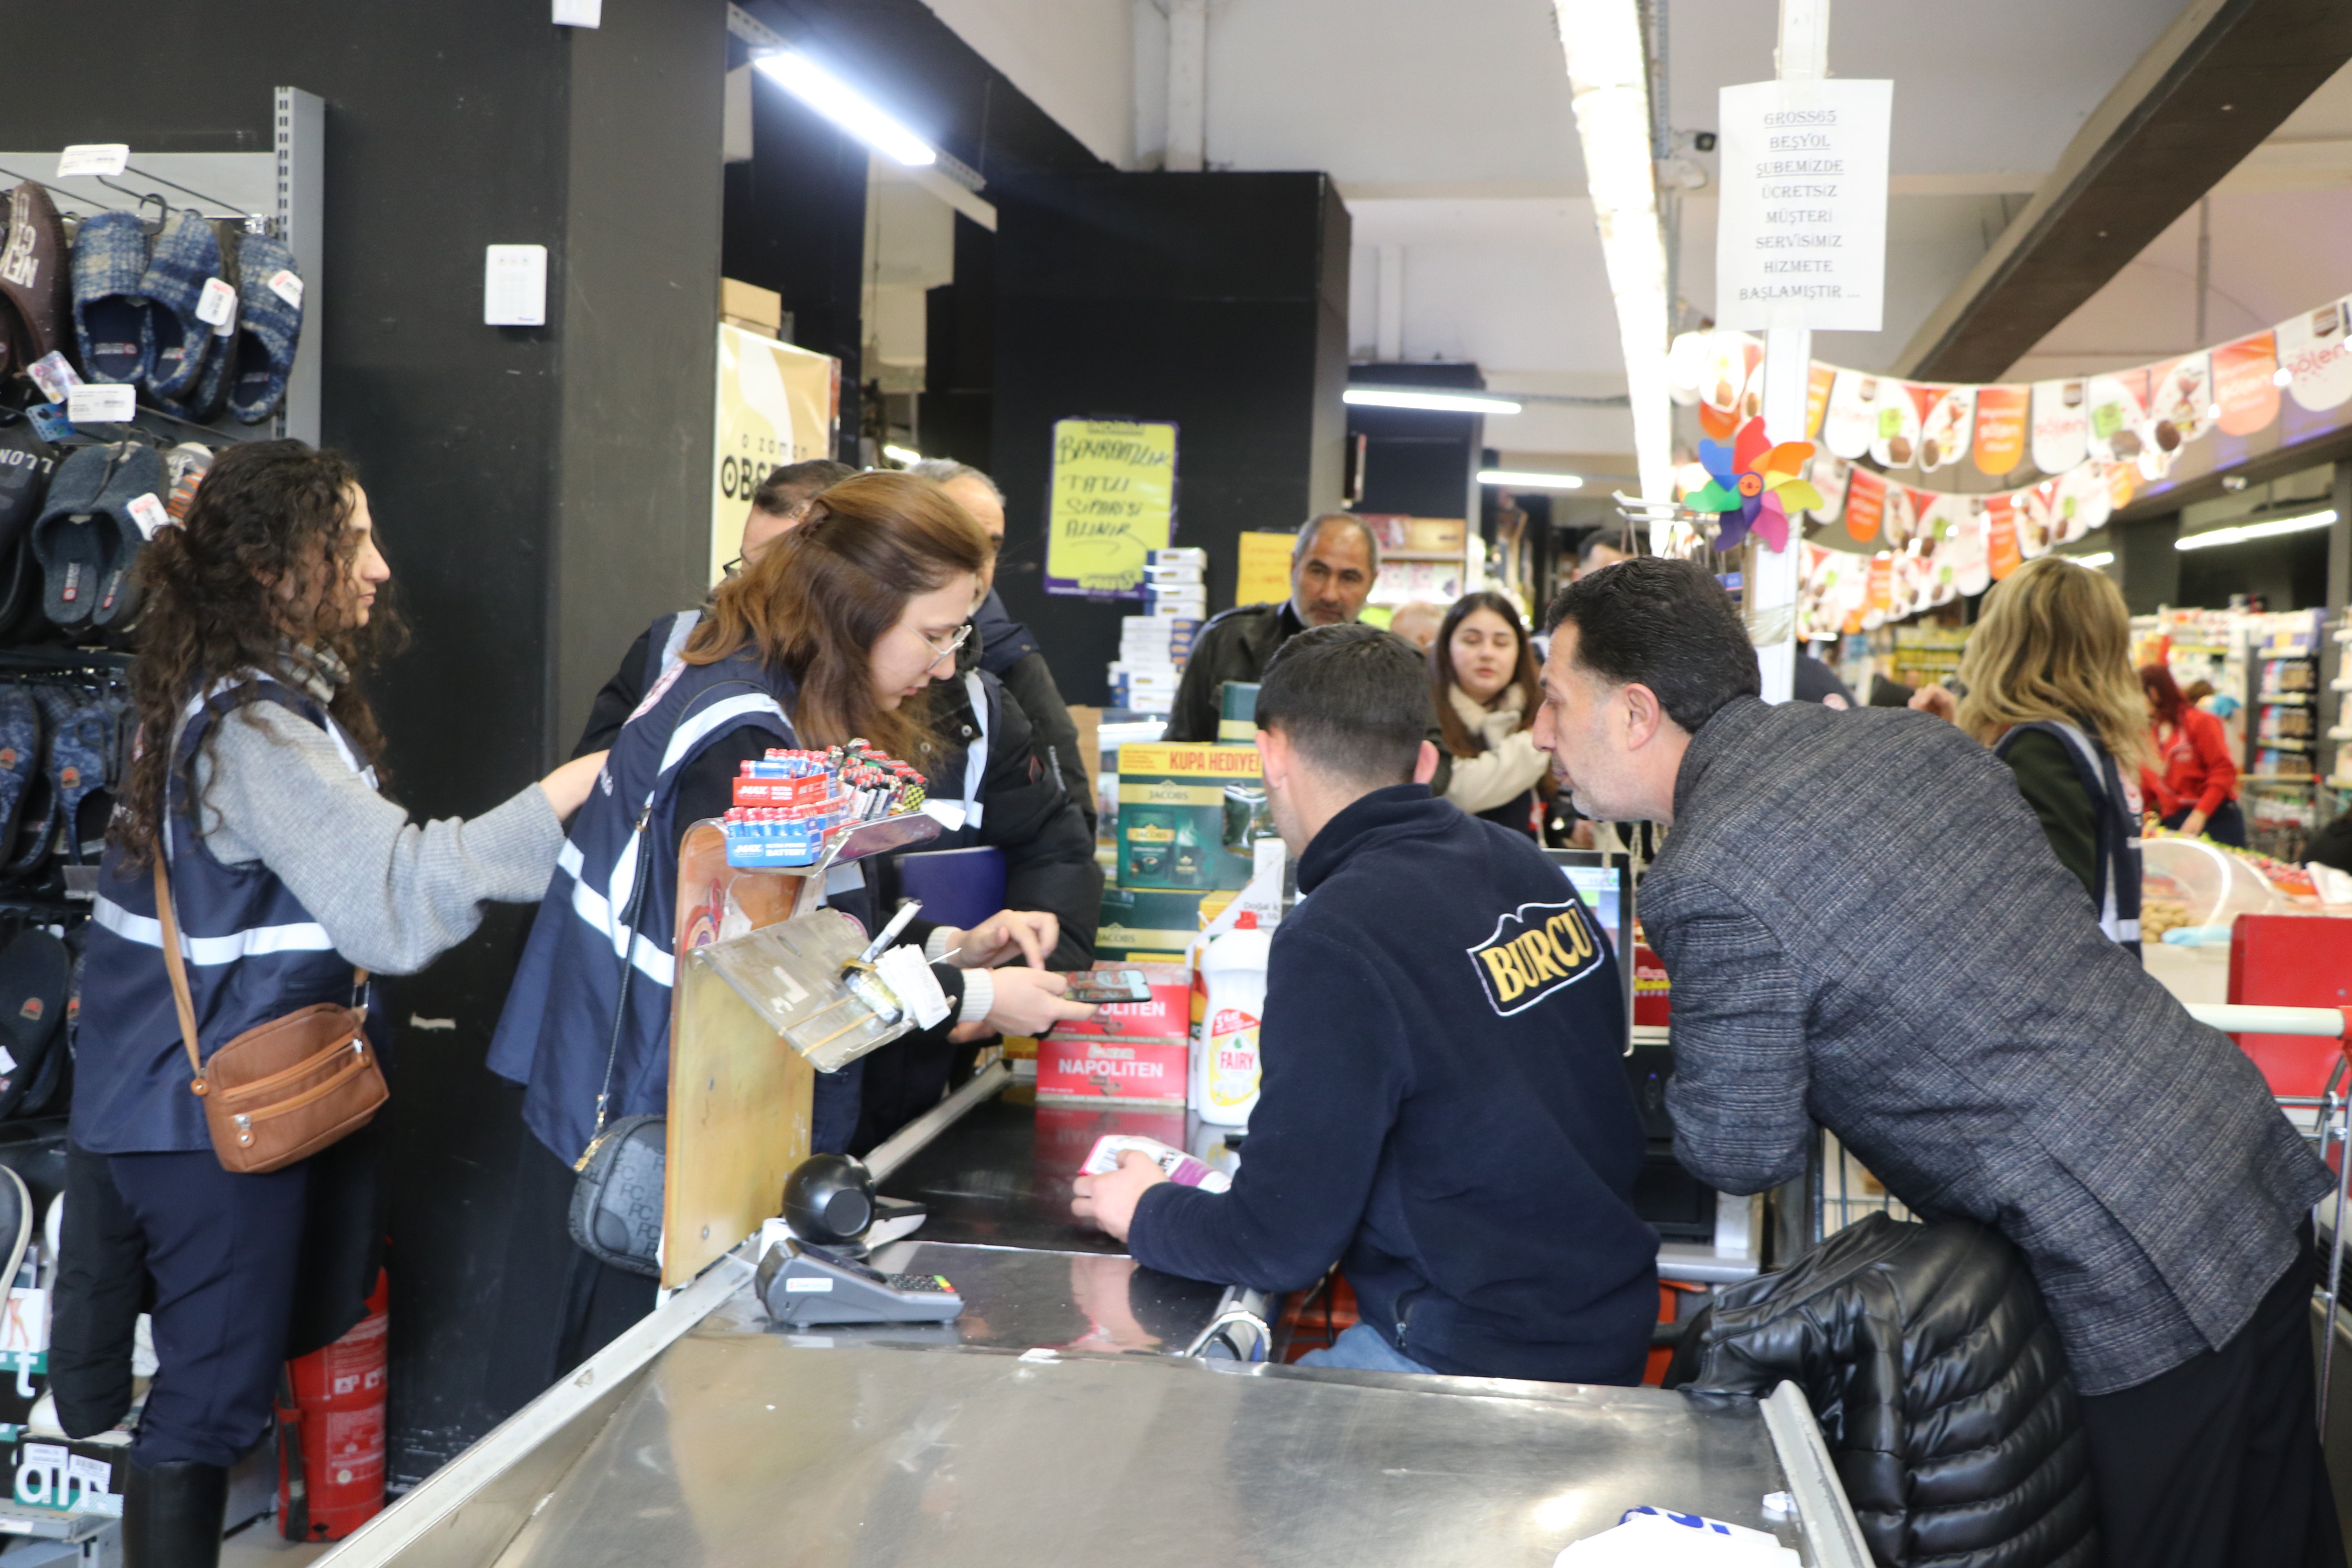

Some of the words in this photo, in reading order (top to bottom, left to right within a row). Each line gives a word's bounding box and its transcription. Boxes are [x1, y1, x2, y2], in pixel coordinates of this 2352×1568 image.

[1764, 110, 1837, 125] GROSS65
[1762, 183, 1838, 199] ÜCRETSİZ
[1766, 208, 1833, 225] MÜŞTERİ
[1764, 259, 1833, 274] HİZMETE
[1170, 751, 1205, 770] KUPA
[1479, 908, 1592, 1002] BURCU
[1220, 1051, 1255, 1070] FAIRY
